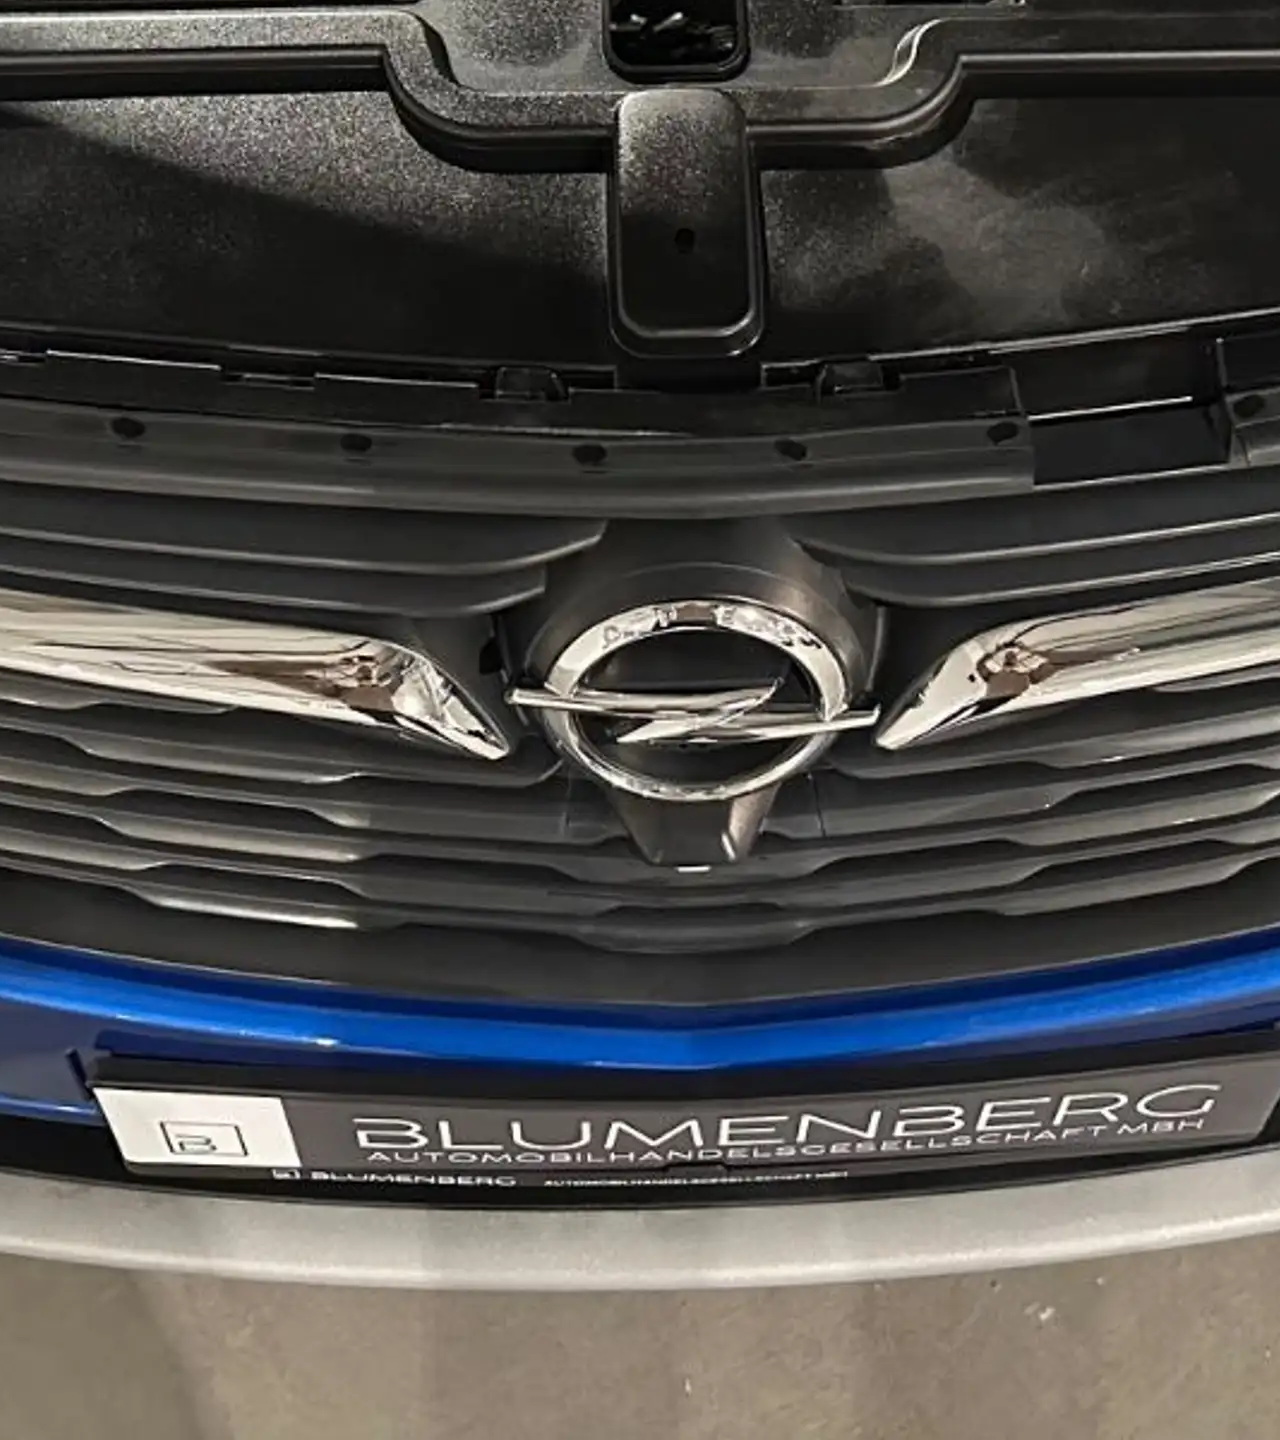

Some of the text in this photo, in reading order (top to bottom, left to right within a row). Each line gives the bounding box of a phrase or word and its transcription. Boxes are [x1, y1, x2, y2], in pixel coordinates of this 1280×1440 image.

[352, 1084, 1221, 1151] BLUMENBERG
[366, 1117, 1206, 1164] AUTOMOBILHANDELSGESELLSCHAFT MBH
[310, 1169, 517, 1188] BLUMENBERG
